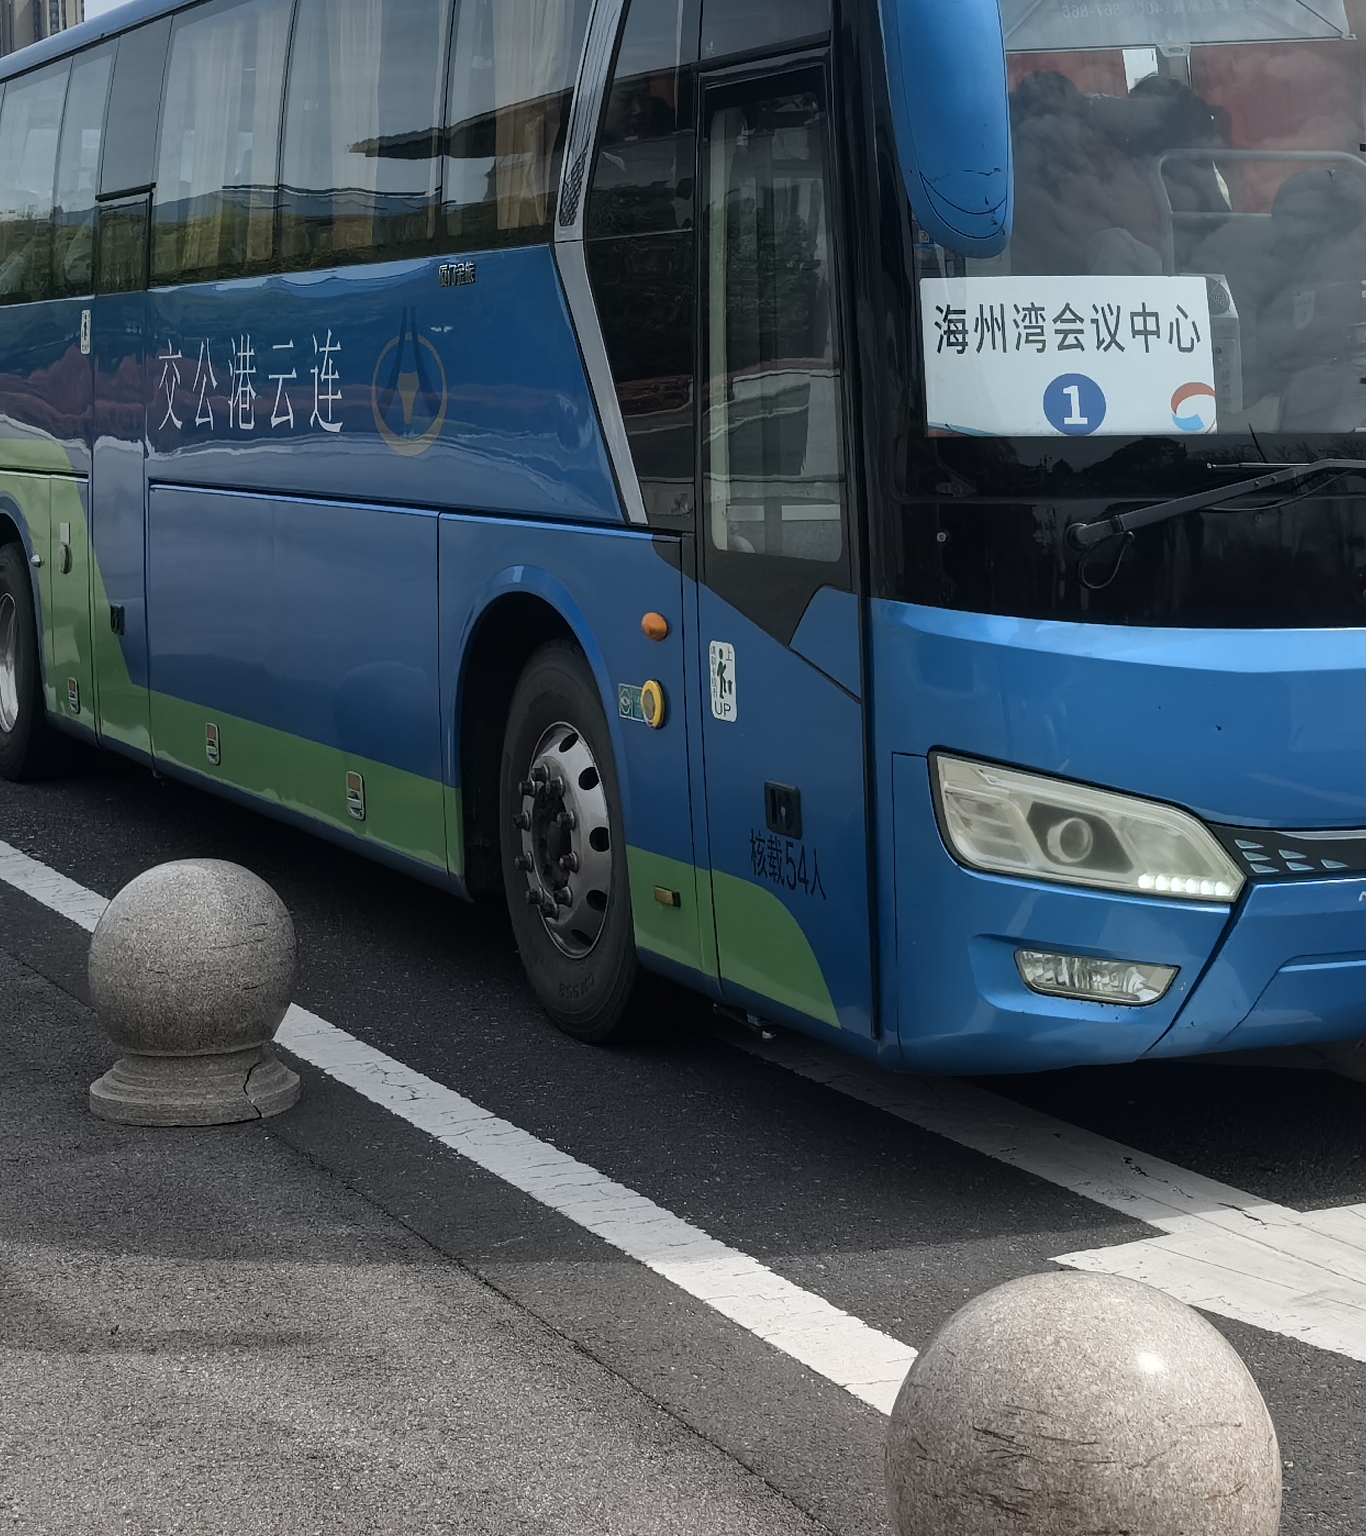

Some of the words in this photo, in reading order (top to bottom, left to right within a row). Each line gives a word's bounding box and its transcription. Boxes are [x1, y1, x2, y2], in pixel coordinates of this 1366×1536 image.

[934, 301, 1202, 355] 海州湾会议中心
[1062, 384, 1089, 425] 1
[713, 700, 732, 717] UP
[749, 828, 827, 900] 核载54人
